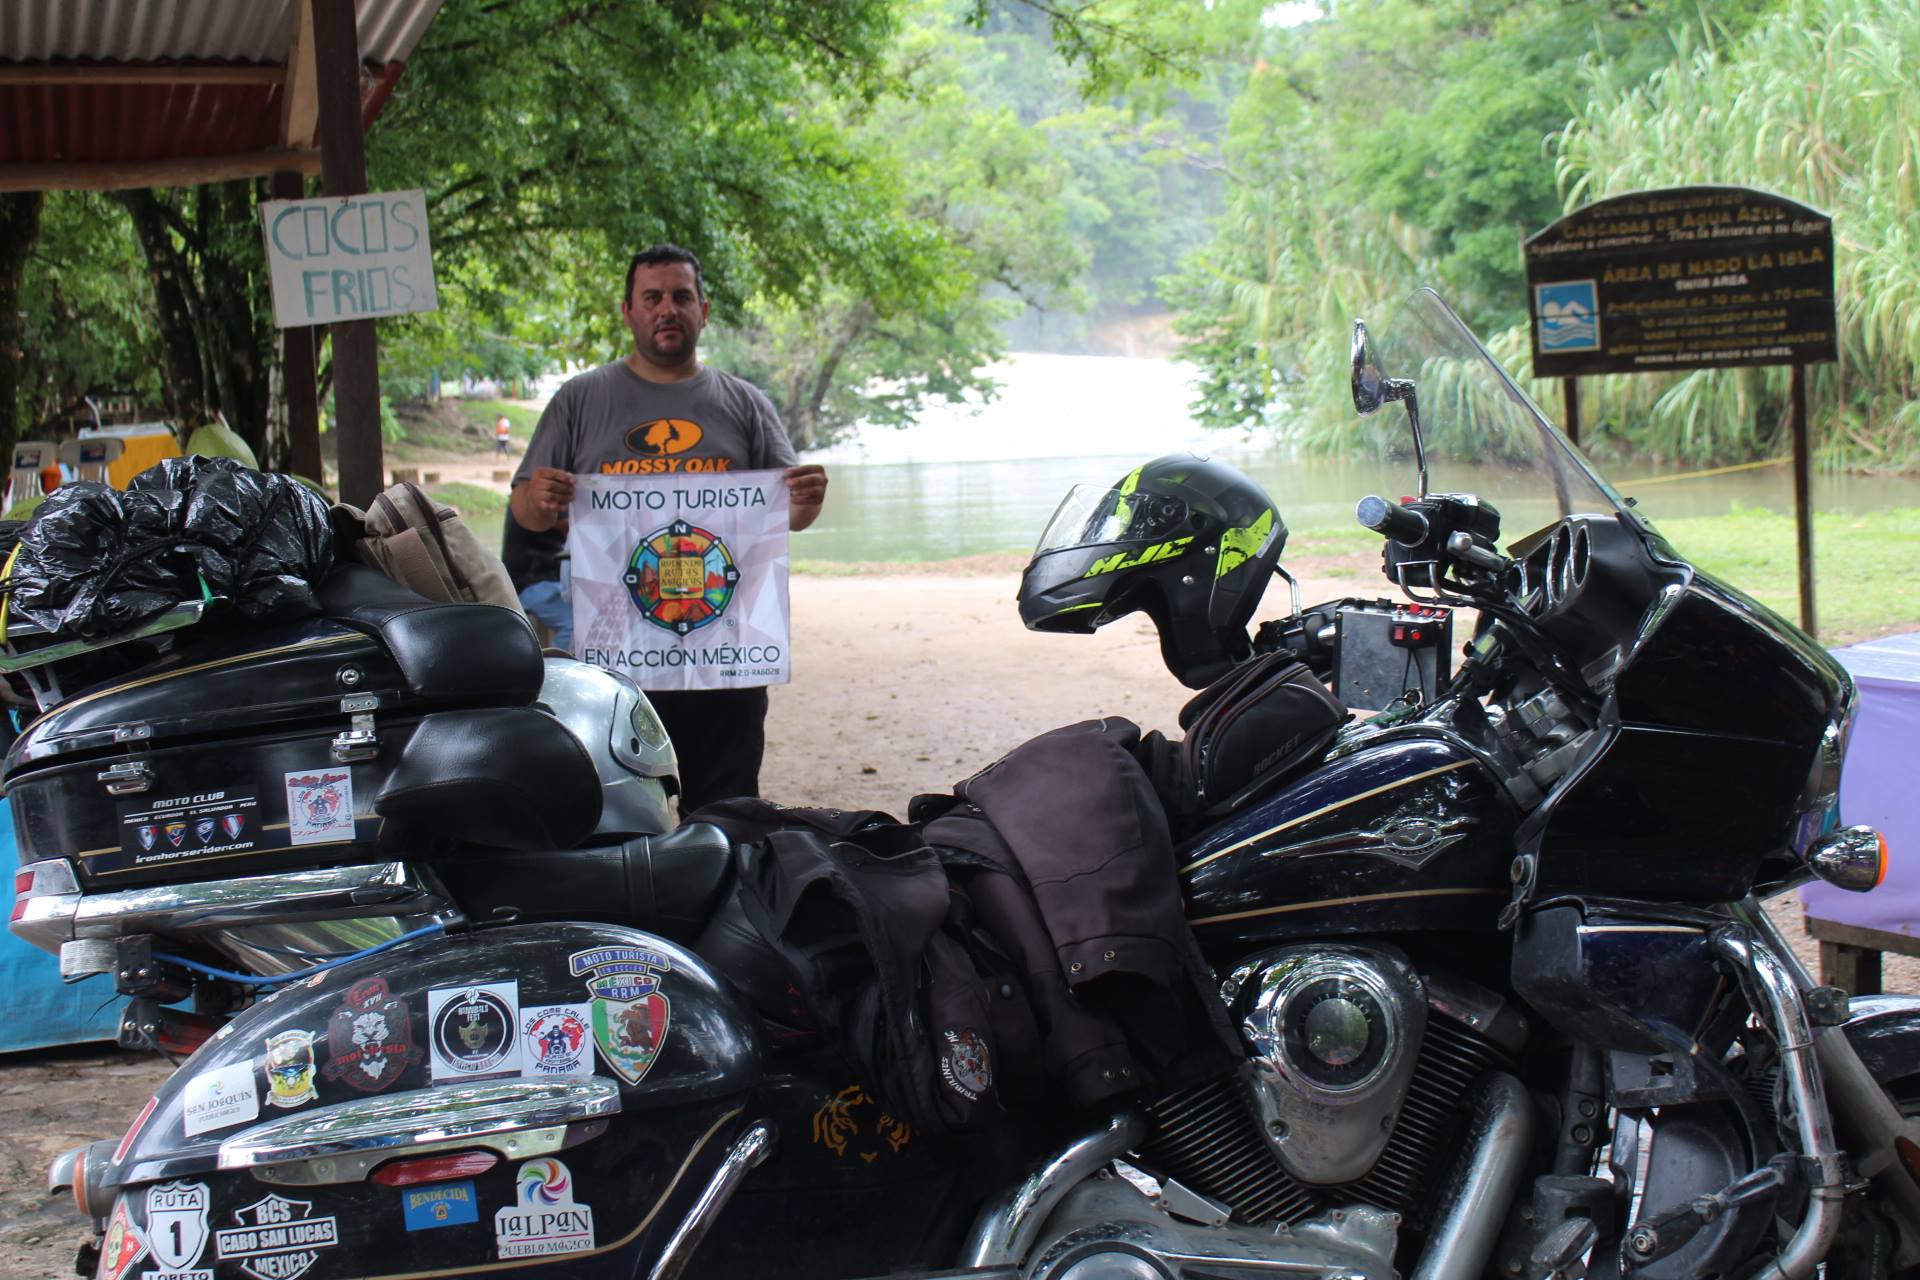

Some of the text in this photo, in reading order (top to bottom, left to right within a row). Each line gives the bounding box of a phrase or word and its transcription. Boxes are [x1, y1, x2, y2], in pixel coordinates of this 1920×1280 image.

[1737, 205, 1785, 222] AZUL
[272, 201, 419, 260] COCOS
[1657, 262, 1681, 280] DE
[1688, 256, 1742, 276] NADO
[1747, 253, 1773, 271] LA
[1778, 247, 1825, 267] ISLA
[302, 265, 416, 318] FRIOS
[1712, 273, 1748, 287] AREA
[602, 458, 731, 474] MOSSY OAK
[591, 487, 766, 510] MOTO TURISTA
[675, 524, 686, 533] N
[1082, 535, 1195, 579] HJC
[727, 572, 737, 581] E
[678, 622, 688, 631] S
[585, 643, 780, 667] EN ACCIÓN MÉXICO
[152, 791, 225, 809] MOTO CLUB
[135, 841, 254, 864] ironhorserider.com
[582, 949, 658, 967] MOTO TURISTA
[611, 987, 640, 999] RRM
[522, 1007, 590, 1035] LOS COME CALLE
[535, 1060, 582, 1075] PANAMA
[154, 1194, 199, 1208] RUTA
[409, 1187, 469, 1210] BENDECIDA
[256, 1200, 291, 1225] BCS
[170, 1220, 182, 1257] 1
[221, 1222, 333, 1253] CABO SAN LUCAS
[255, 1252, 308, 1278] MEXICO
